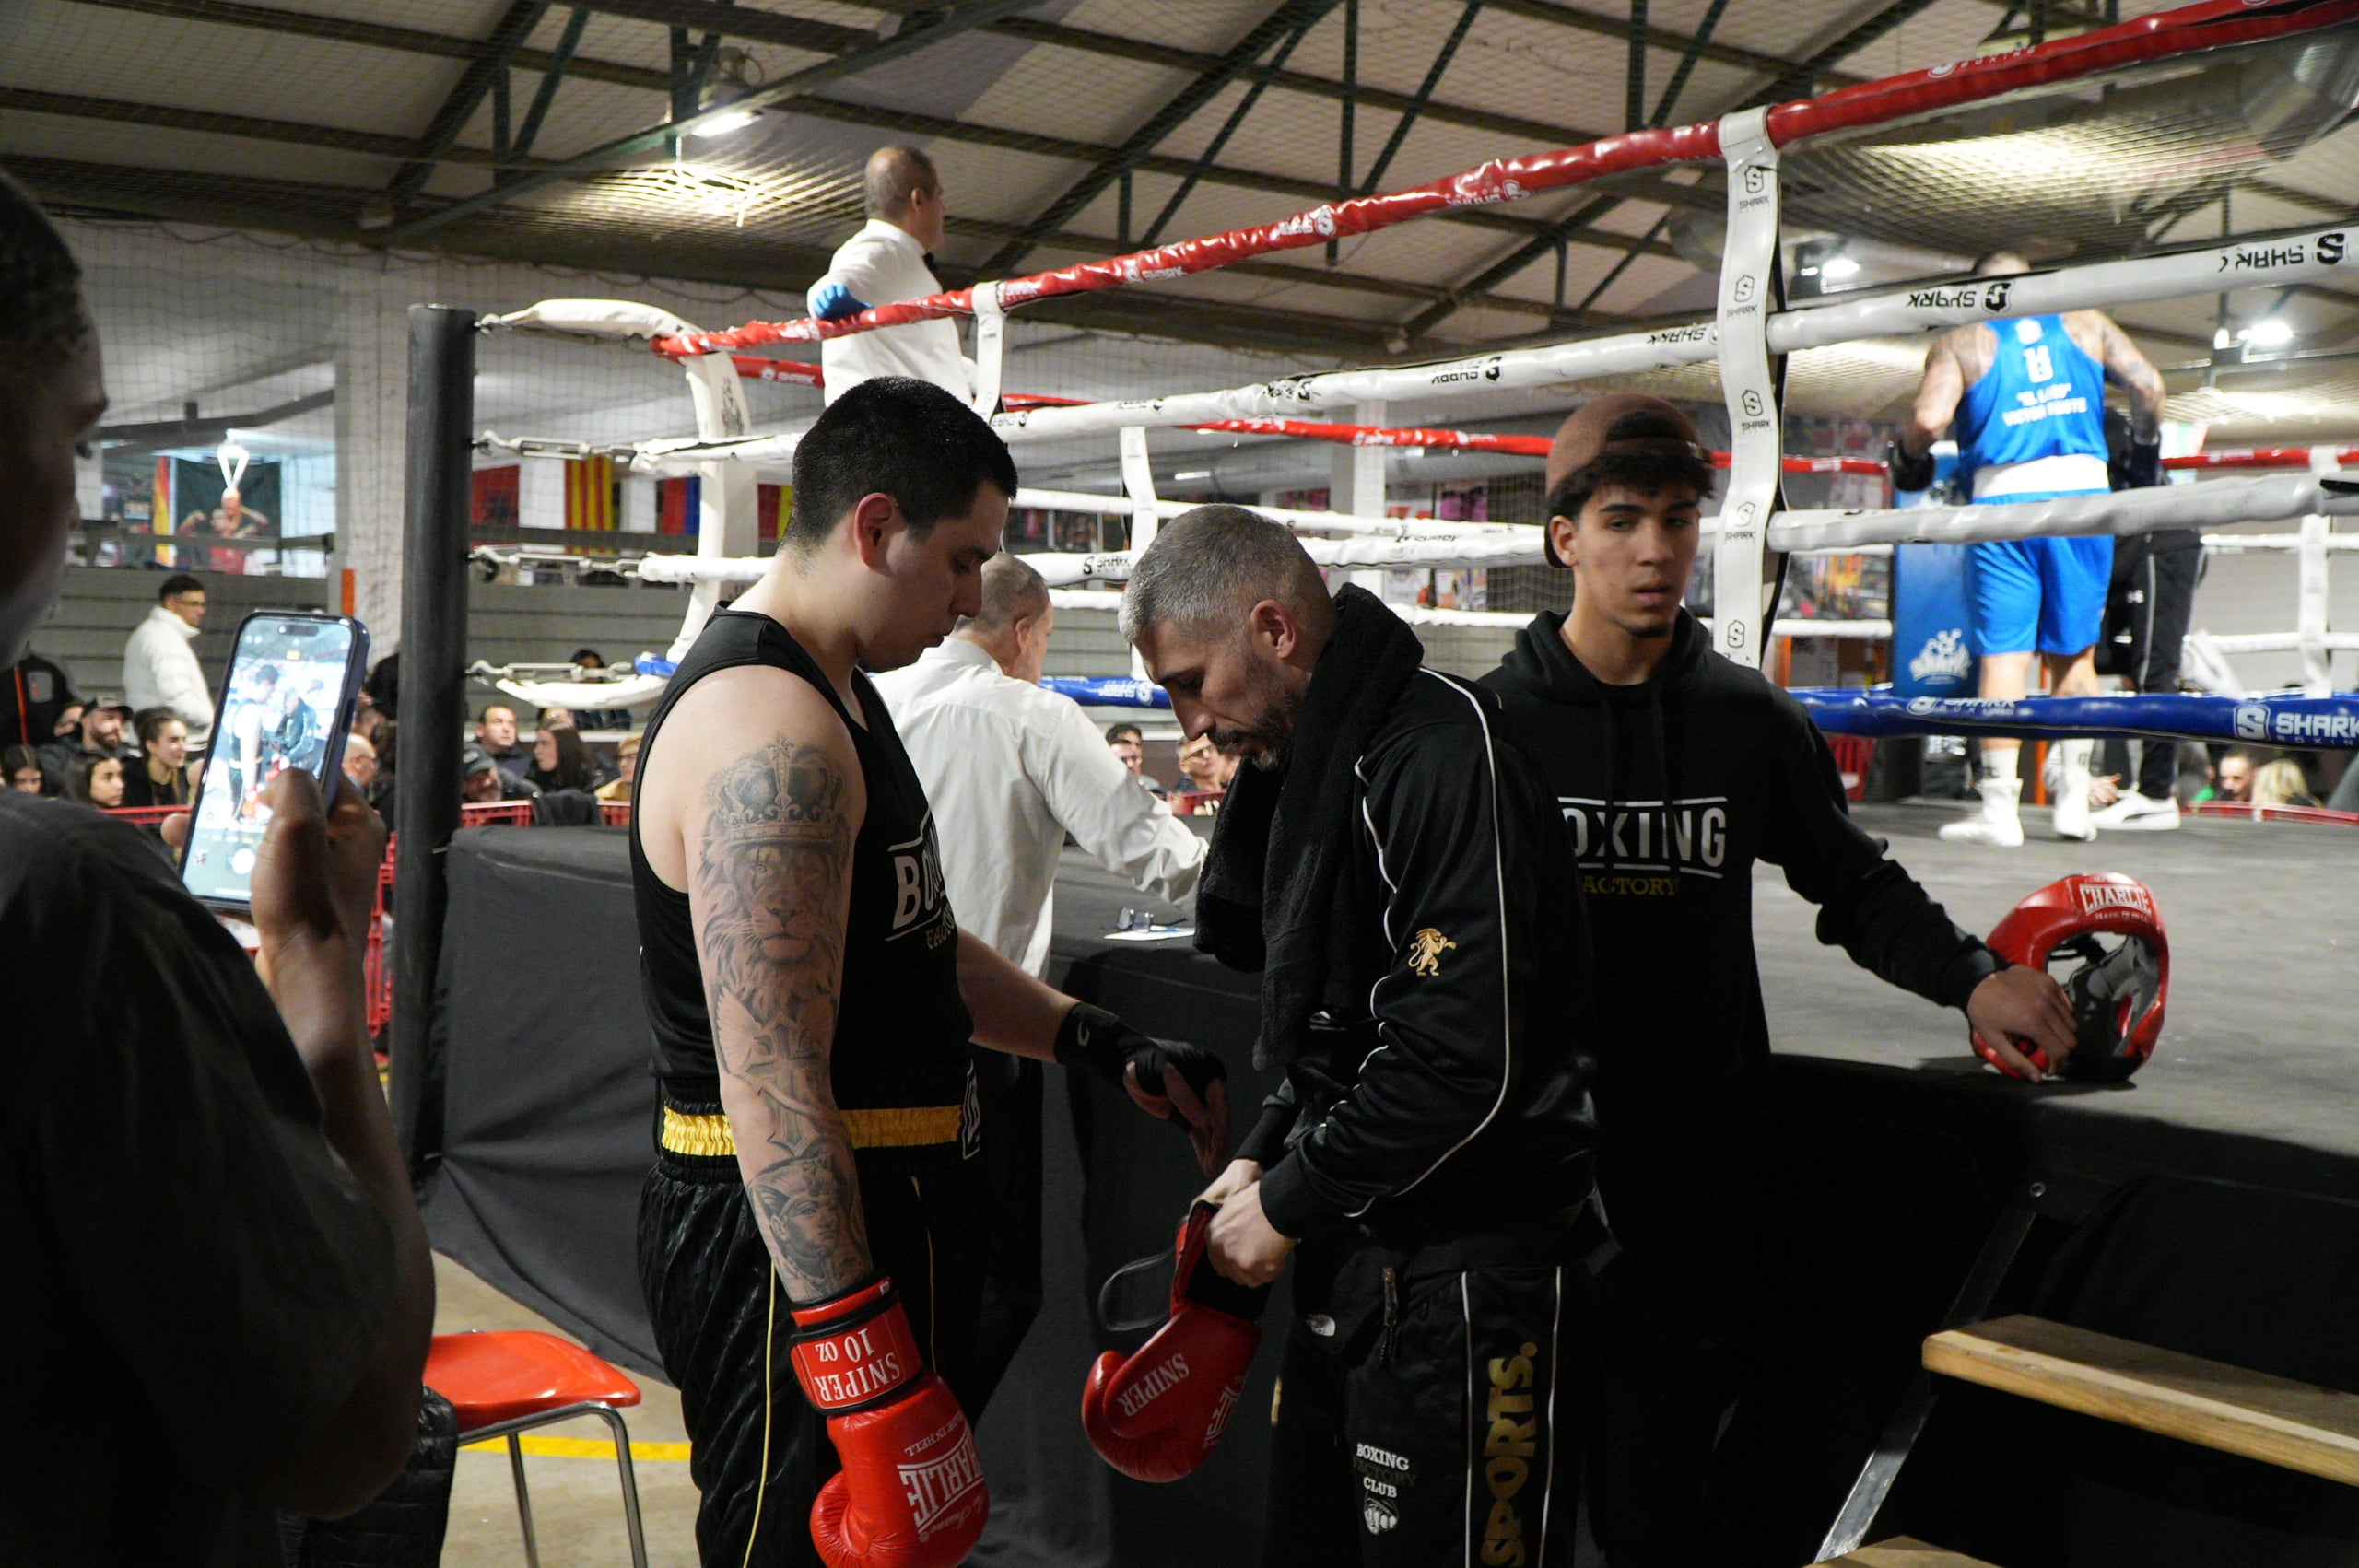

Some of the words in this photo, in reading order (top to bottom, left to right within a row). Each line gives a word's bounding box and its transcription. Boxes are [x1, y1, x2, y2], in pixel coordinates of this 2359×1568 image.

[1739, 195, 1770, 210] SHARK
[1725, 303, 1758, 319] SHARK
[1741, 419, 1772, 432] SHARK
[1724, 529, 1756, 541] SHARK
[1562, 807, 1727, 868] OXING
[1582, 874, 1679, 896] ACTORY
[2080, 884, 2152, 916] CHARLIE
[815, 1341, 839, 1363] OZ
[843, 1328, 876, 1363] 10
[814, 1352, 901, 1402] SNIPER
[1116, 1352, 1191, 1418] SNIPER
[1356, 1442, 1411, 1472] BOXING
[898, 1438, 984, 1529] HARLIE
[1362, 1475, 1398, 1500] CLUB
